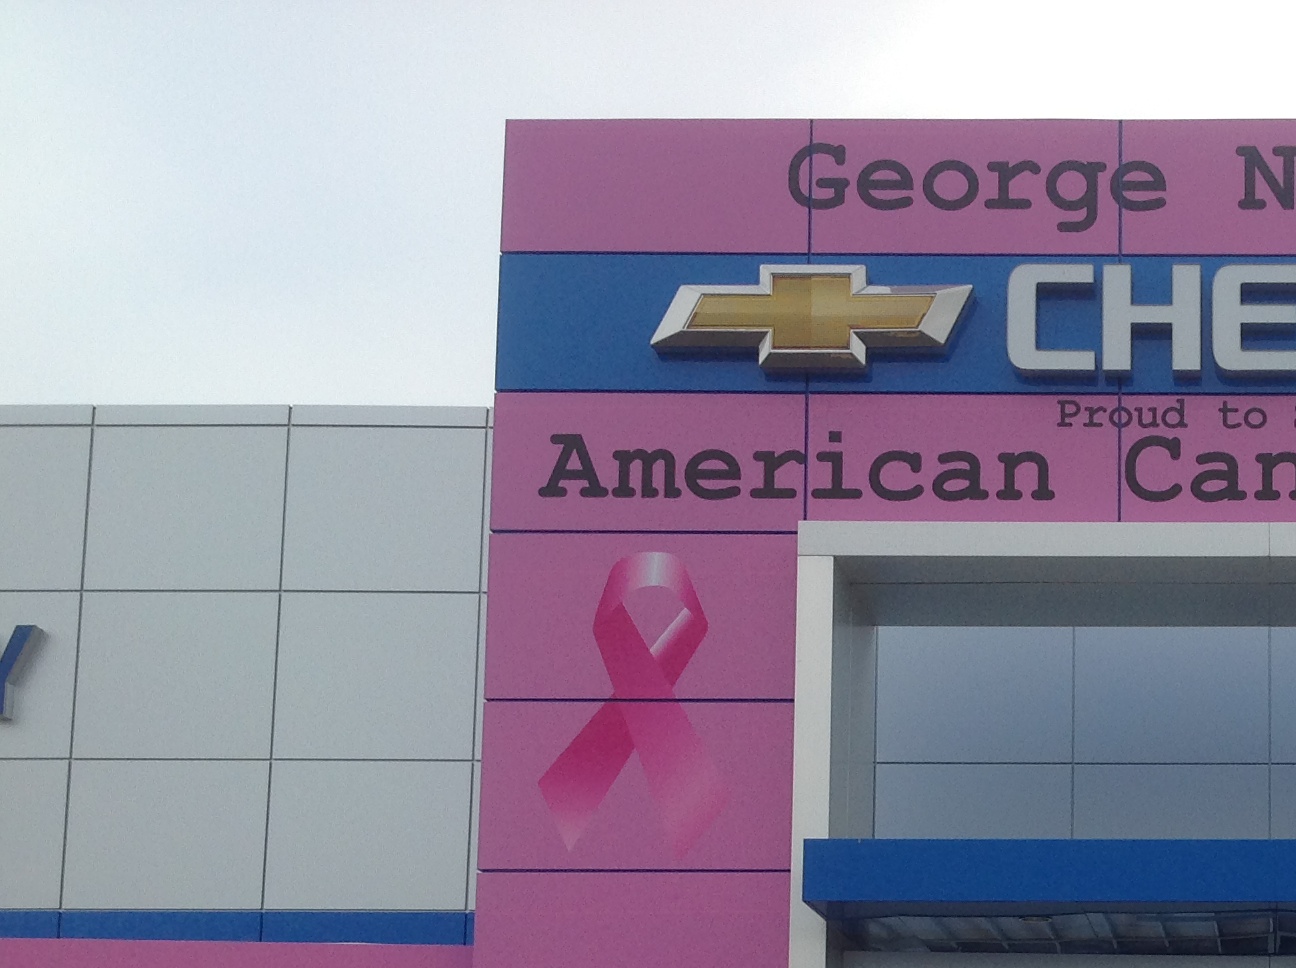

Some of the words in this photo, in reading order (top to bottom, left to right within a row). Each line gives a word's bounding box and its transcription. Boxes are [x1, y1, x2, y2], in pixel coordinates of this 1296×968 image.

[789, 142, 1167, 233] George
[1057, 398, 1188, 429] Proud
[1219, 400, 1268, 429] to
[538, 431, 1056, 502] American
